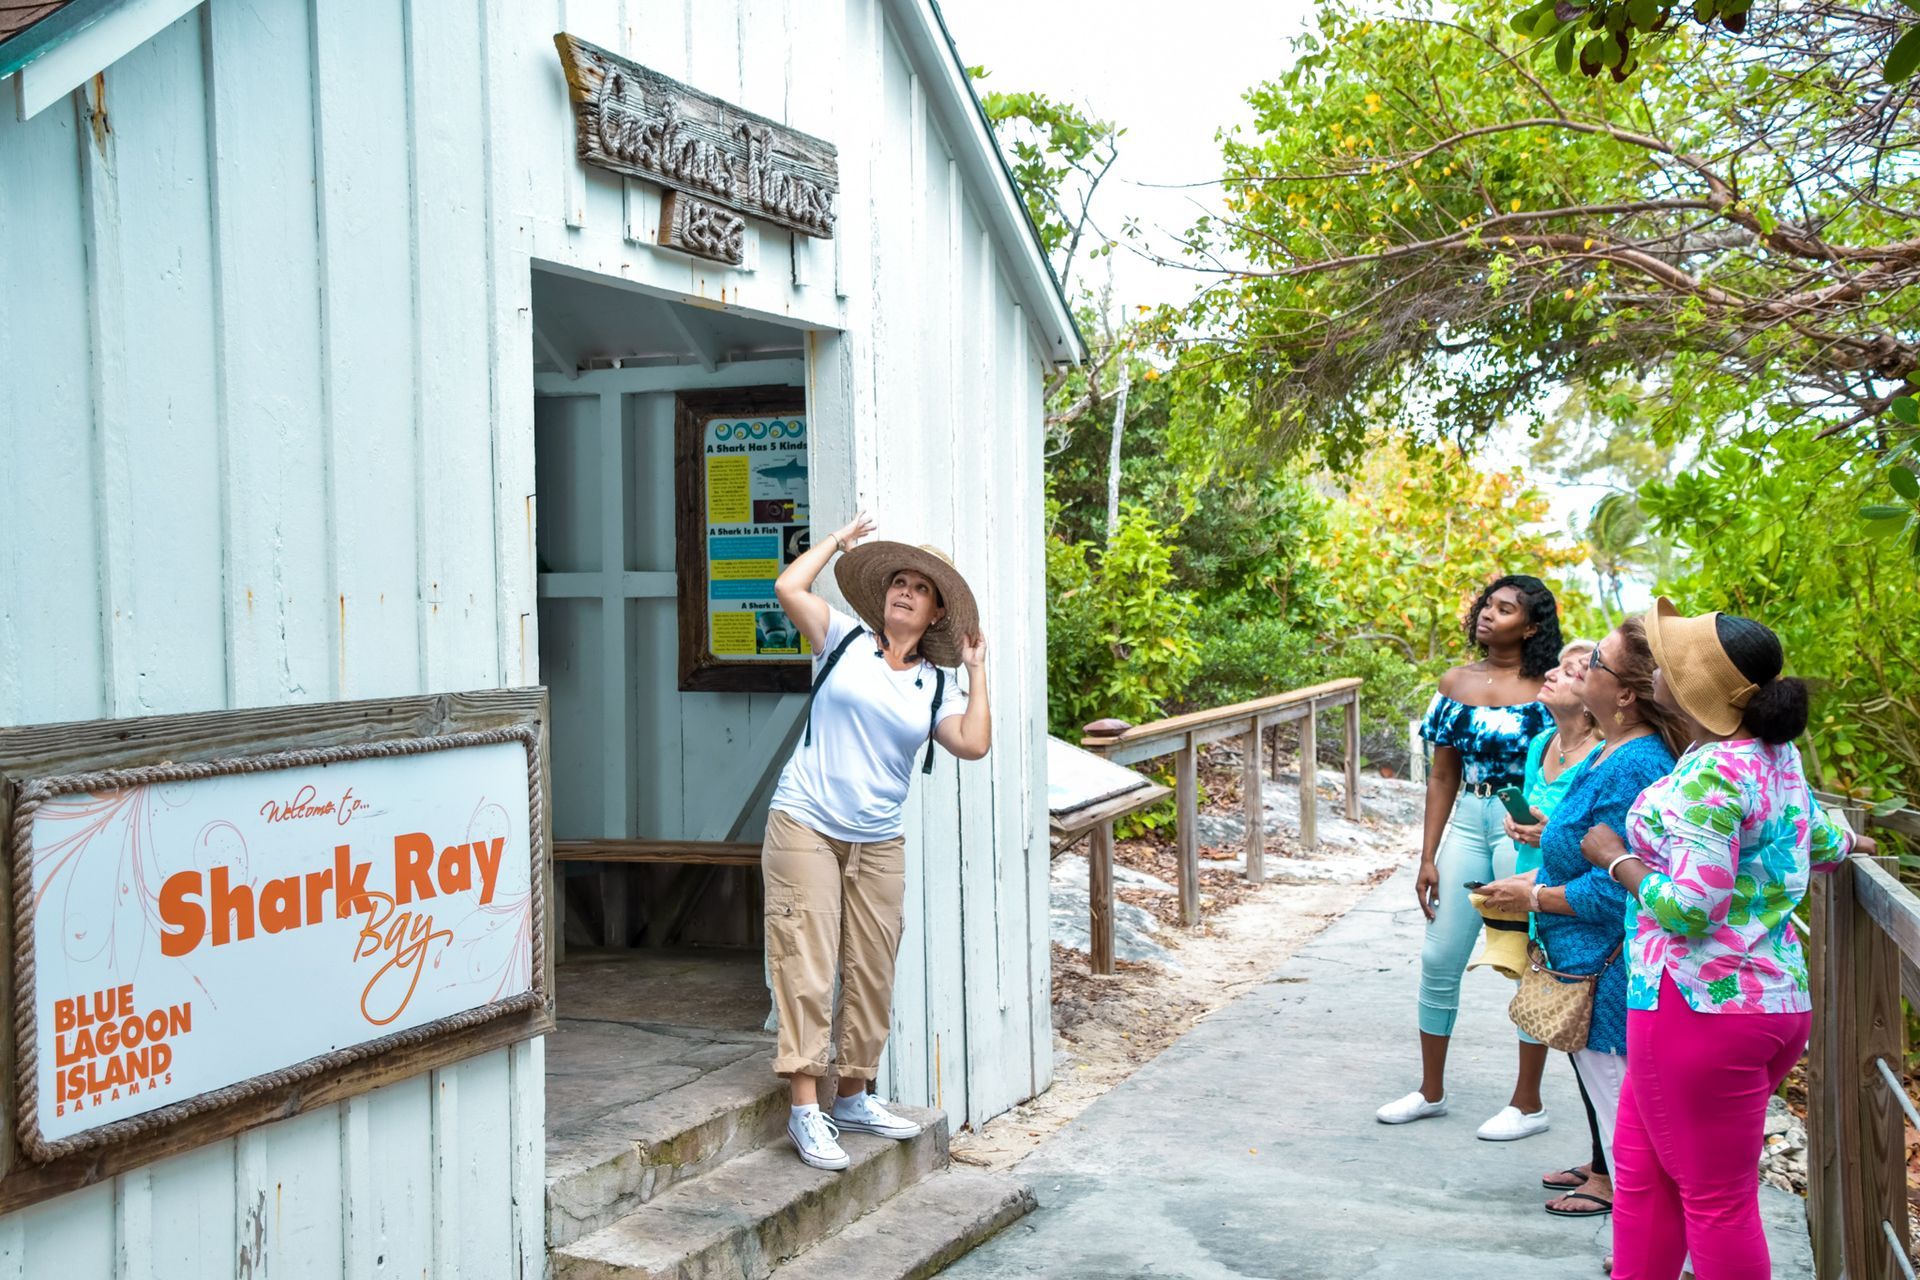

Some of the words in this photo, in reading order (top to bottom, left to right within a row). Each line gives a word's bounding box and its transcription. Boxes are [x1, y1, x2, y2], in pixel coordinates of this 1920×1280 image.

[707, 445, 714, 453] A
[717, 443, 745, 452] Shark
[748, 442, 768, 451] Has
[770, 442, 777, 450] 5
[780, 441, 807, 450] Kinds
[260, 785, 336, 823] Welcome
[159, 844, 373, 957] Shark
[394, 832, 505, 907] Ray
[339, 890, 454, 1026] Bay
[54, 983, 135, 1034] BLUE
[54, 1002, 192, 1068] LAGOON
[55, 1042, 172, 1103] ISLAND
[55, 1072, 173, 1118] BAHAMAS
